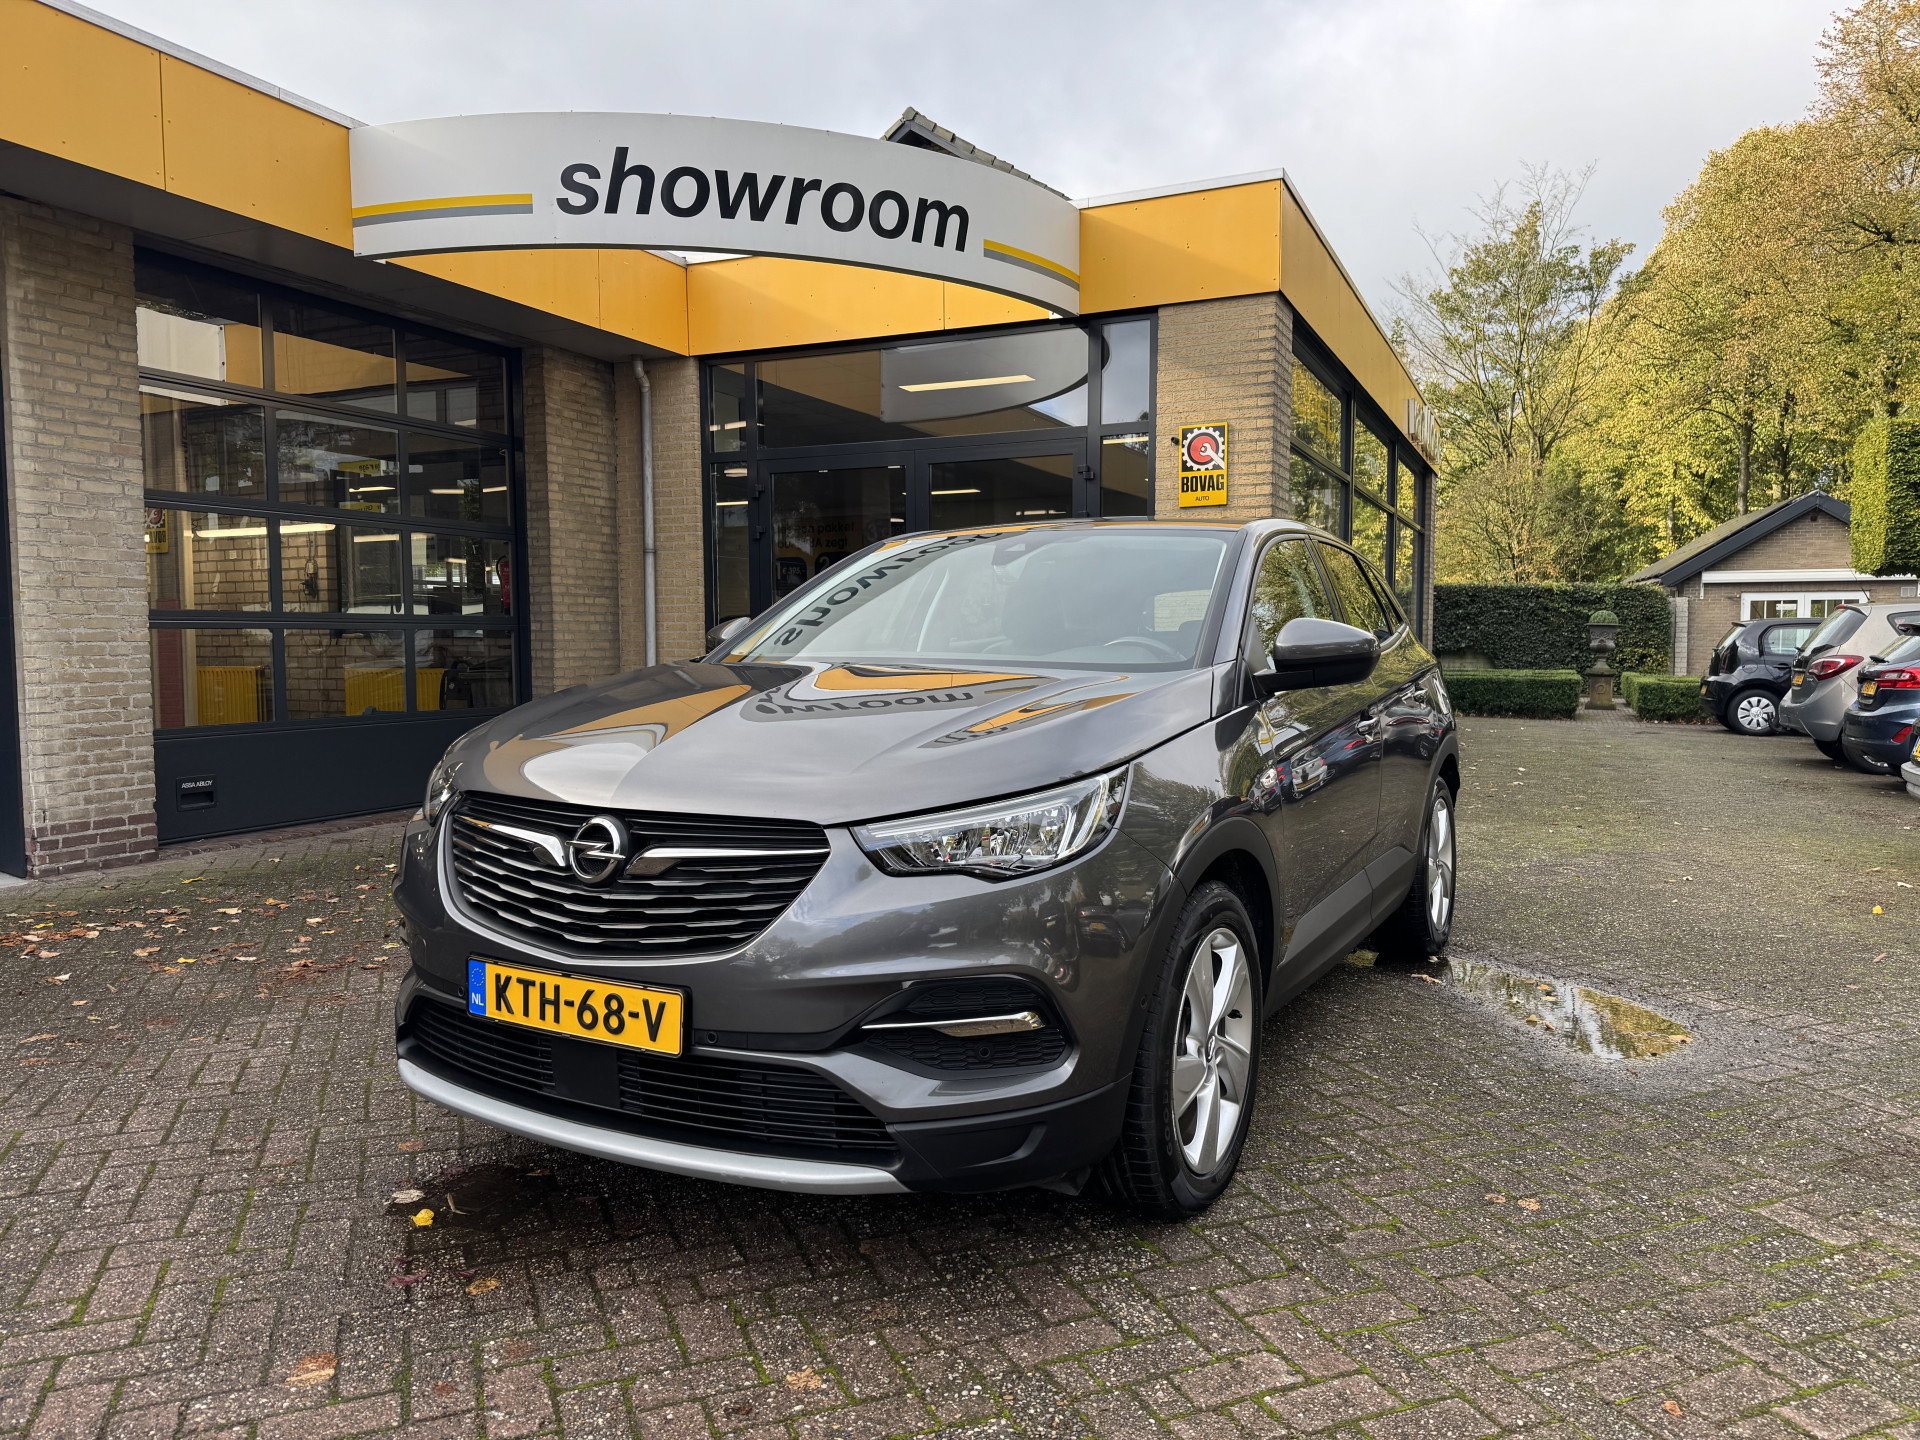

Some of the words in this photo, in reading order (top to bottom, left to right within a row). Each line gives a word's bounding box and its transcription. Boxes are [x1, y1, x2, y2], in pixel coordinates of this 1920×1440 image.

[556, 146, 970, 253] showroom
[1181, 474, 1225, 493] BOVAG
[471, 992, 484, 1006] NL
[495, 973, 666, 1042] KTH-68-V
